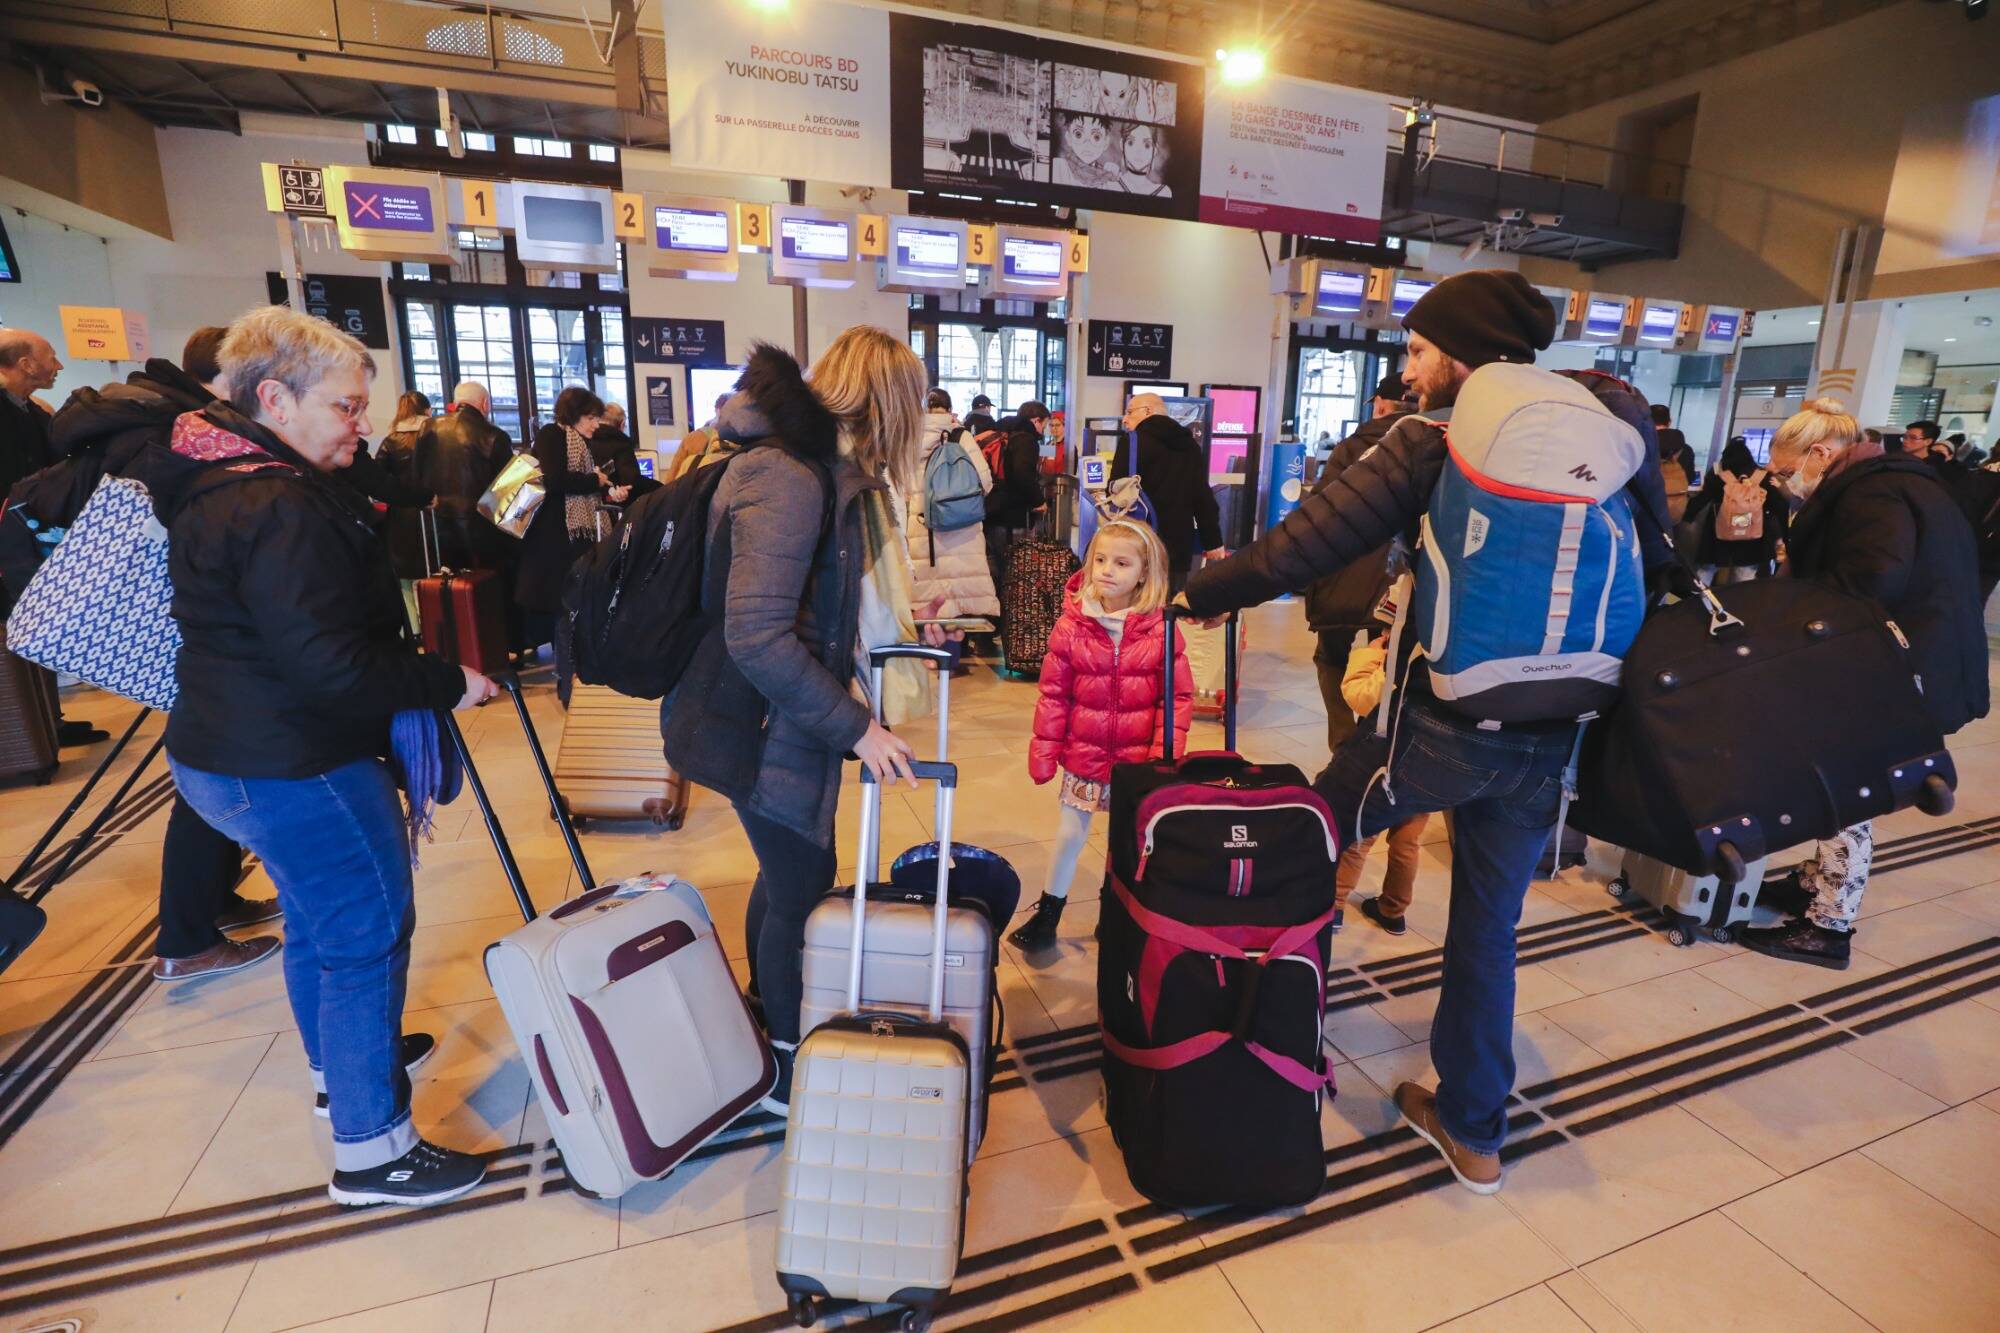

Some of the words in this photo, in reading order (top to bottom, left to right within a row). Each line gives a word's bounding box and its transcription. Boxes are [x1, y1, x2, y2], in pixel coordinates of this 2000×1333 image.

[751, 45, 832, 69] PARCOURS
[838, 58, 858, 73] BD
[725, 60, 809, 85] YUKINOBU
[814, 73, 858, 92] TATSU
[715, 114, 732, 124] SUR
[733, 117, 745, 126] LA
[747, 119, 796, 131] PASSERELLE
[834, 129, 860, 139] QUAIS
[1231, 112, 1243, 121] 50
[1245, 114, 1275, 128] GARES
[1278, 119, 1303, 132] POUR
[1305, 124, 1315, 135] 50
[1318, 126, 1336, 138] ANS
[1247, 103, 1279, 116] BANDE
[1282, 108, 1322, 124] DESSINÉE
[1325, 117, 1338, 128] EN
[474, 191, 485, 216] 1
[623, 203, 636, 228] 2
[749, 213, 760, 238] 3
[865, 224, 876, 247] 4
[974, 234, 983, 255] 5
[1072, 242, 1081, 263] 6
[1370, 275, 1377, 292] 7
[347, 316, 363, 332] G
[678, 331, 687, 339] A
[695, 331, 704, 340] Y
[1131, 332, 1140, 345] A
[1154, 333, 1163, 345] Y
[1127, 357, 1161, 367] Ascenseur
[1522, 663, 1572, 674] Quechua
